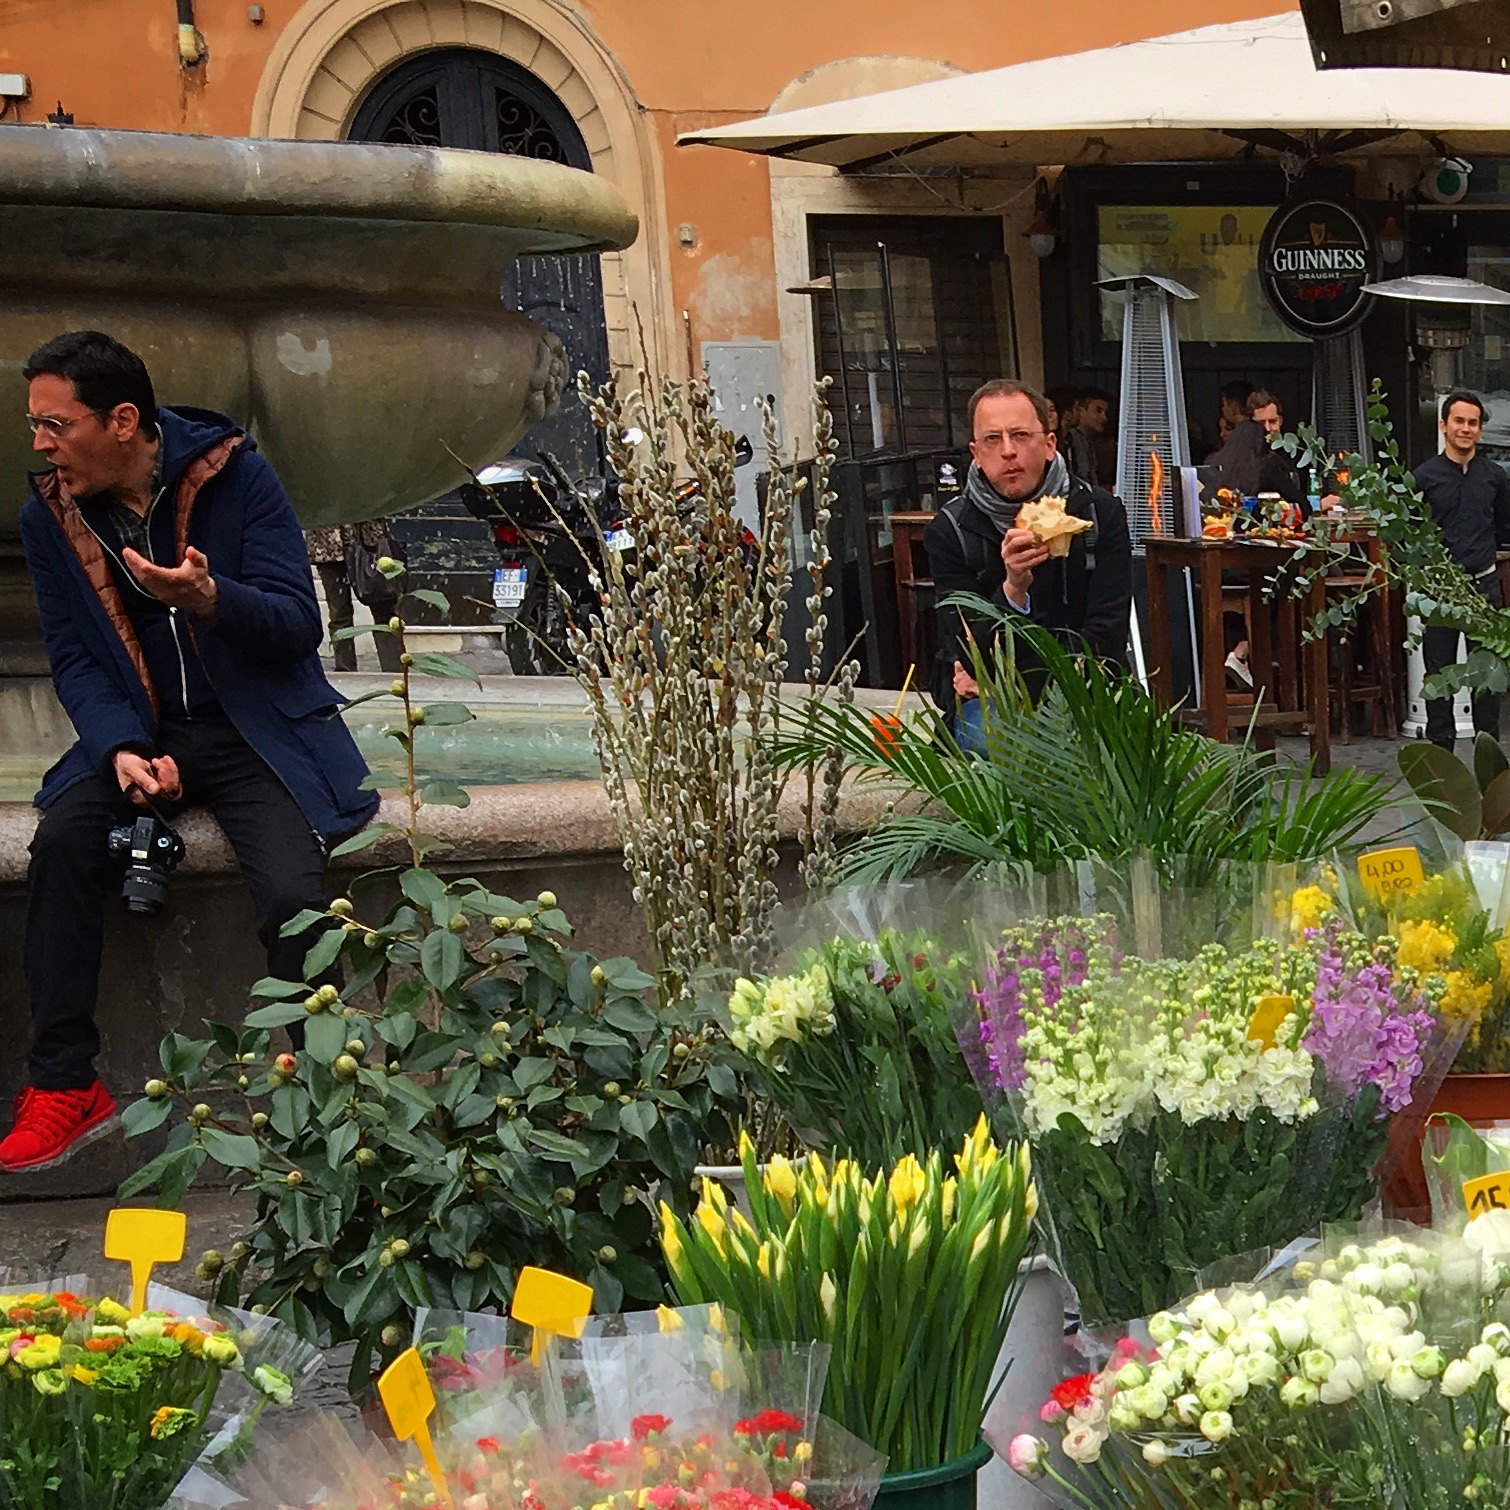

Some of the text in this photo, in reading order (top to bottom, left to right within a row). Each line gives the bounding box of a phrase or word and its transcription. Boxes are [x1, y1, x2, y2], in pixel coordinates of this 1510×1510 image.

[1273, 248, 1366, 272] GUINNESS
[1298, 272, 1341, 280] DRAUGHT
[495, 584, 522, 597] 33191
